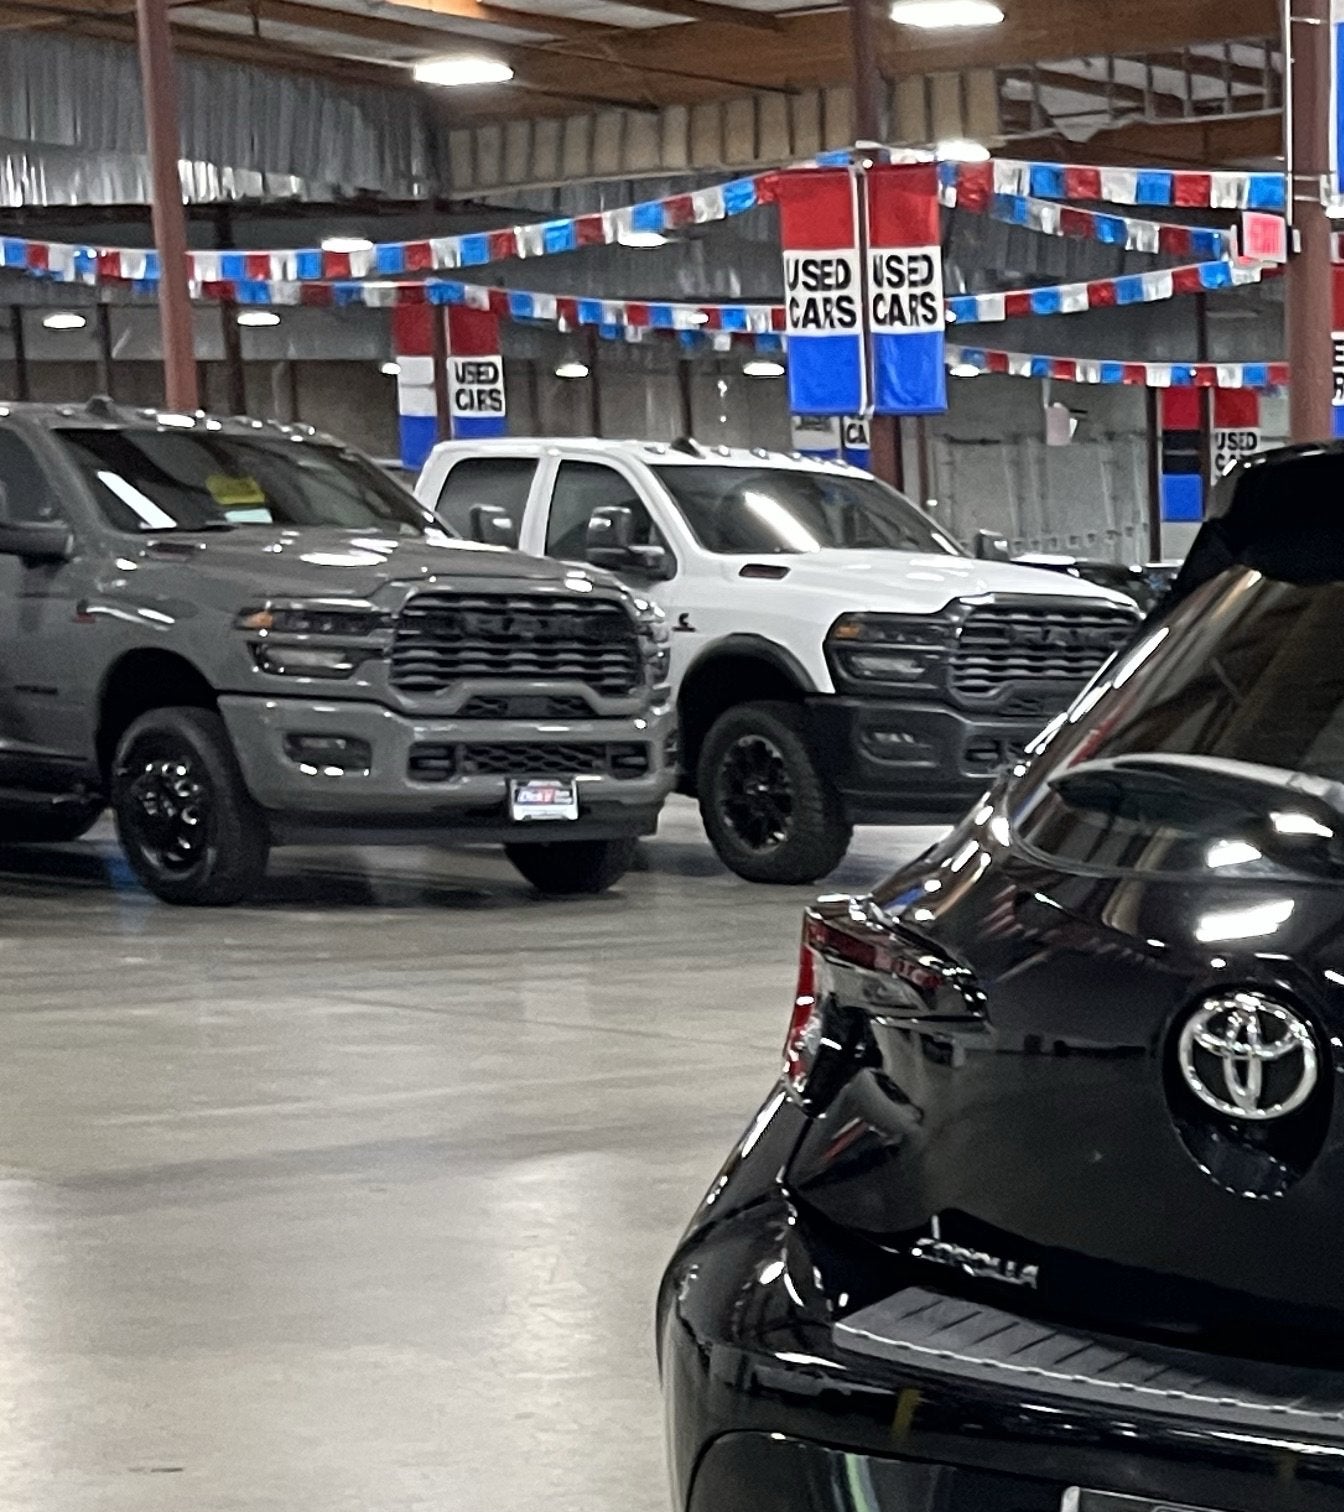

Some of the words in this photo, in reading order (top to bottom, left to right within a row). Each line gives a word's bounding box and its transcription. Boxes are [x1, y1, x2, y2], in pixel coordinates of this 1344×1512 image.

[787, 258, 851, 291] USED
[872, 253, 934, 288] USED
[791, 296, 857, 328] CARS
[873, 292, 938, 327] CARS
